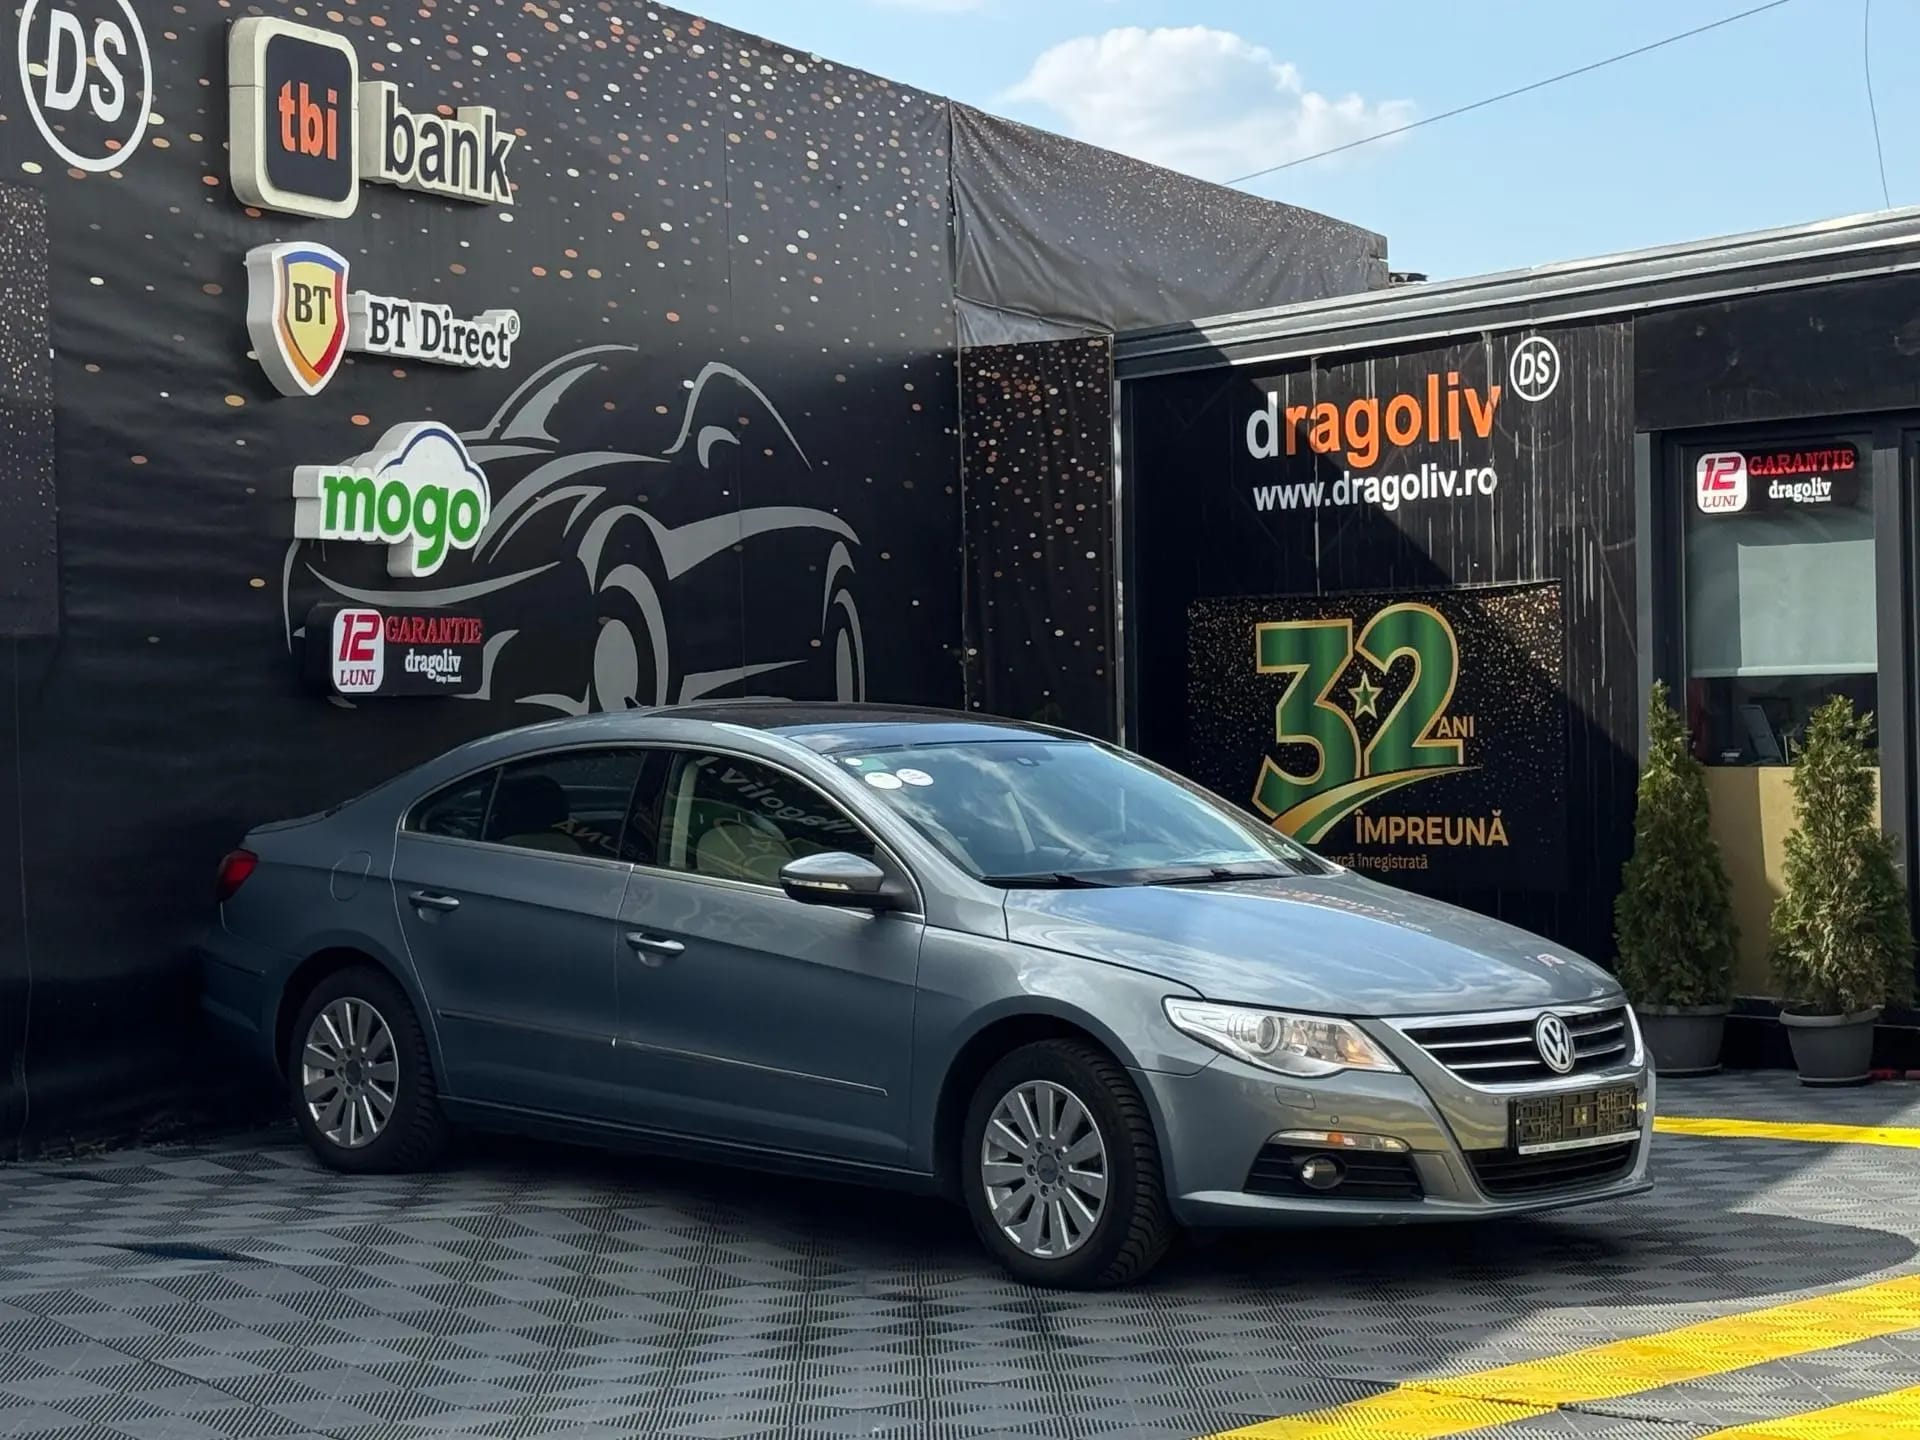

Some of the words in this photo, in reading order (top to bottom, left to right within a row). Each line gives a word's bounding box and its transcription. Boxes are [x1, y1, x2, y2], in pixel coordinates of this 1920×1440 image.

[44, 9, 127, 122] DS
[279, 80, 338, 160] tbi
[384, 90, 512, 199] bank
[293, 281, 331, 325] BT
[369, 302, 411, 348] BT
[1519, 352, 1551, 386] DS
[1246, 372, 1500, 468] dragoliv
[1703, 456, 1740, 491] 12
[1750, 450, 1855, 476] GARANTIE
[1253, 464, 1498, 512] www.dragoliv.ro
[1703, 495, 1738, 509] LUNI
[1768, 477, 1831, 502] dragoliv
[324, 475, 480, 569] mogo
[339, 614, 380, 661] 12
[386, 616, 482, 643] GARANTIE
[340, 669, 375, 686] LUNI
[404, 648, 461, 679] dragoliv
[1252, 602, 1463, 820] 32
[1437, 715, 1474, 738] ANI
[1355, 809, 1508, 846] ÎMPREUNĂ
[1324, 853, 1355, 868] arcă
[1358, 853, 1428, 872] înregistrată
